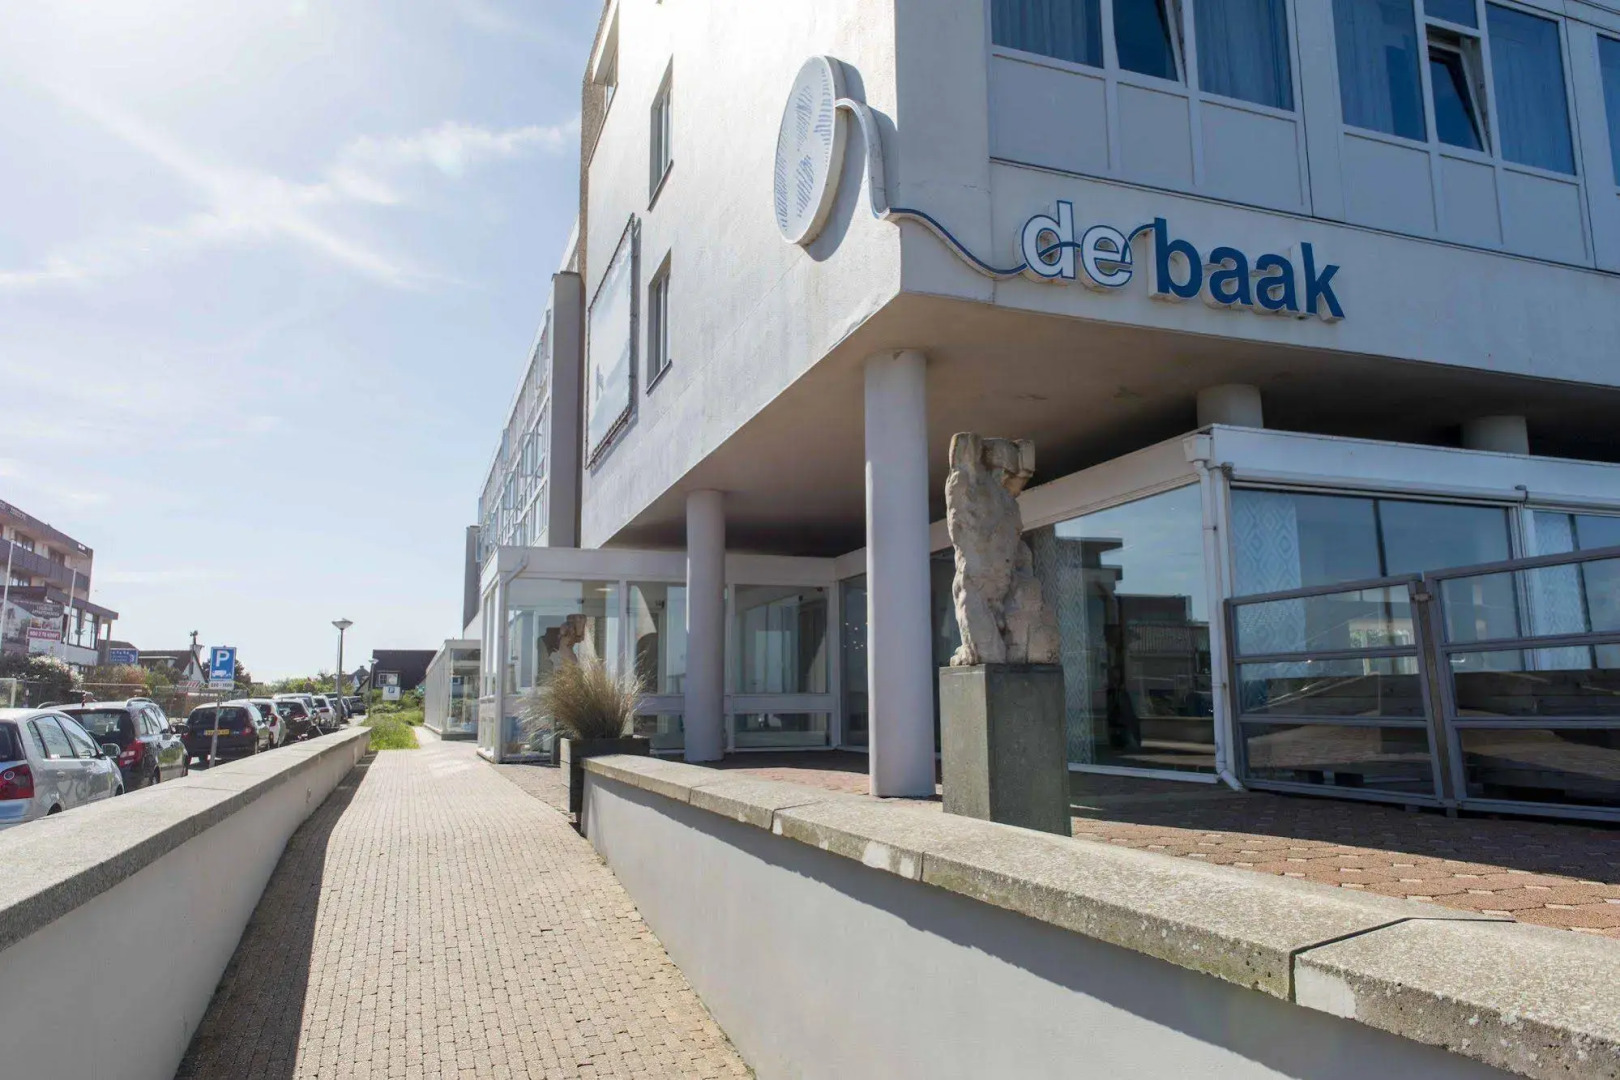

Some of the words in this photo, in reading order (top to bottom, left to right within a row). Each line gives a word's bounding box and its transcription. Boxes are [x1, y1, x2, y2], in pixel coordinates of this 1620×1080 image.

[1019, 199, 1133, 288] de
[1150, 216, 1346, 321] baak
[215, 650, 230, 667] P
